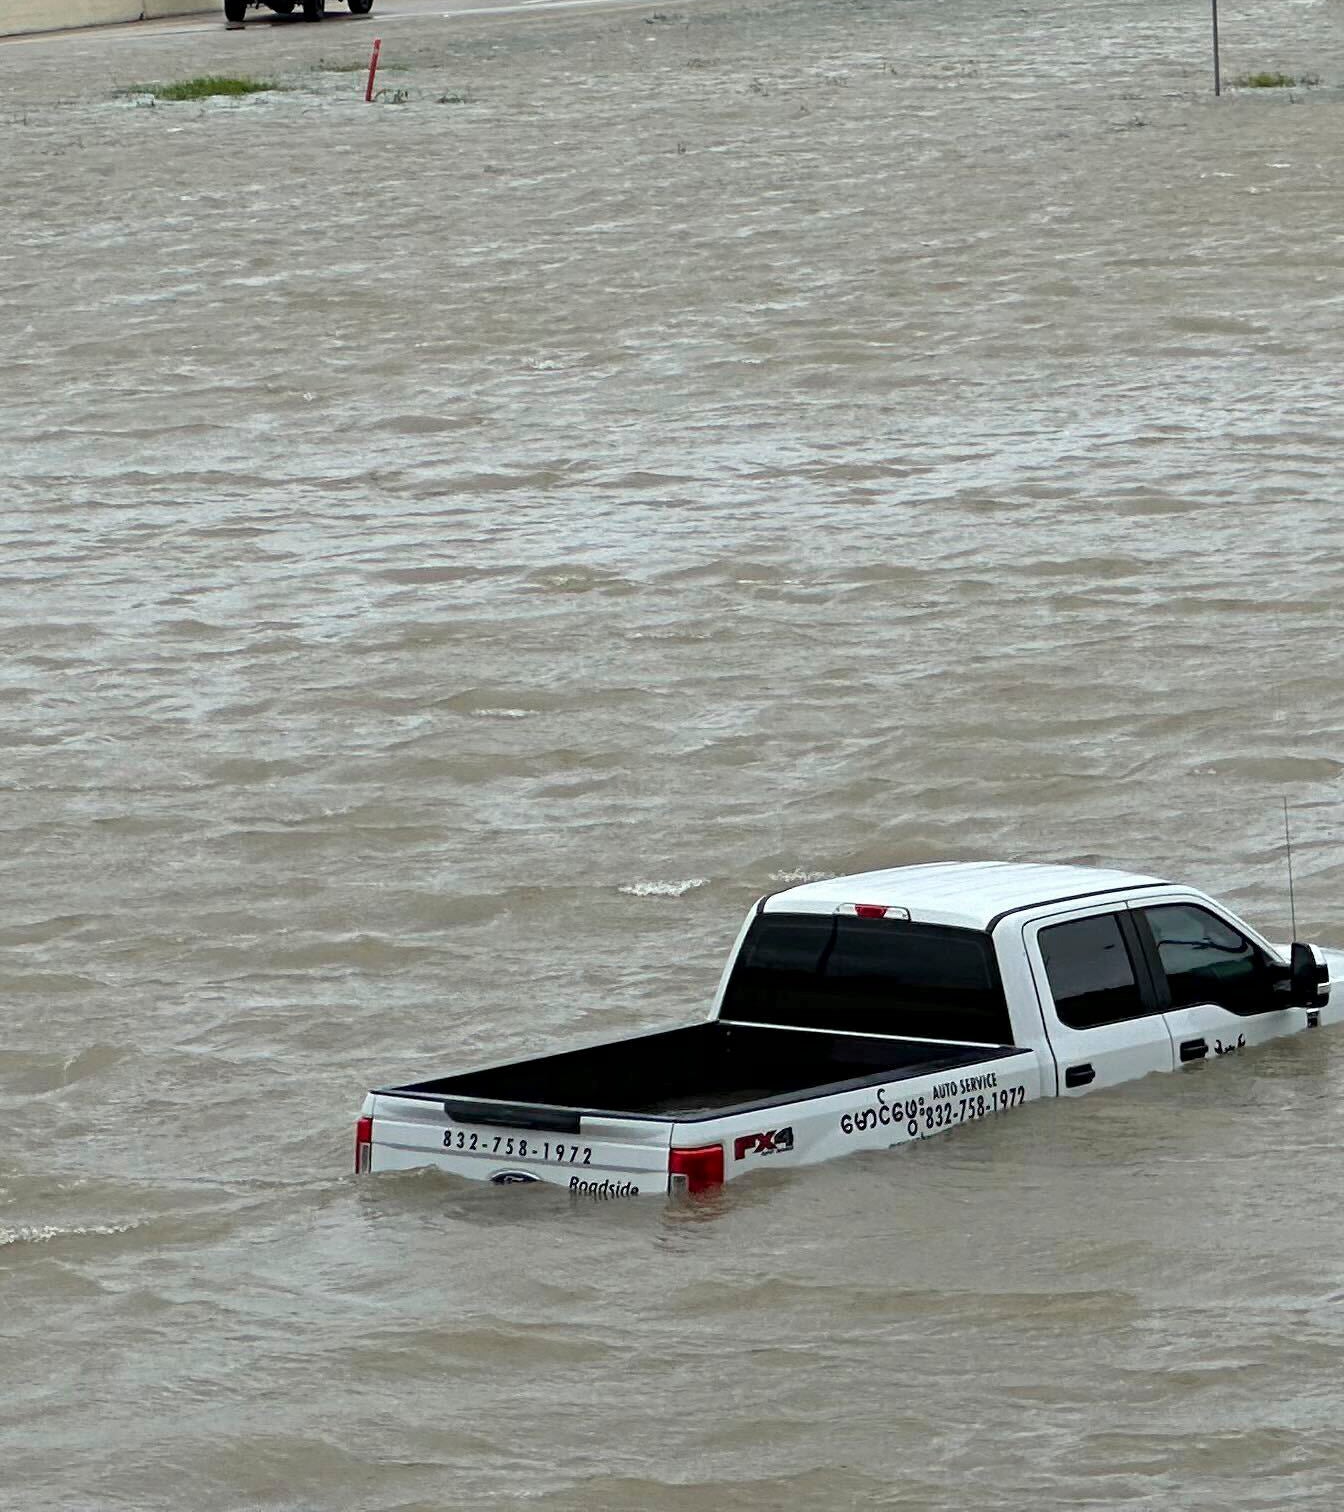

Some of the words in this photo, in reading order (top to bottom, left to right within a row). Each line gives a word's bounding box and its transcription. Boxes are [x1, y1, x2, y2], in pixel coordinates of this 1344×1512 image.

[933, 1081, 958, 1100] AUTO
[960, 1072, 998, 1094] SERVICE
[926, 1085, 1025, 1129] 832-758-1972
[443, 1129, 592, 1165] 832-758-1972
[734, 1126, 794, 1161] FX4
[569, 1176, 640, 1197] Roadside
